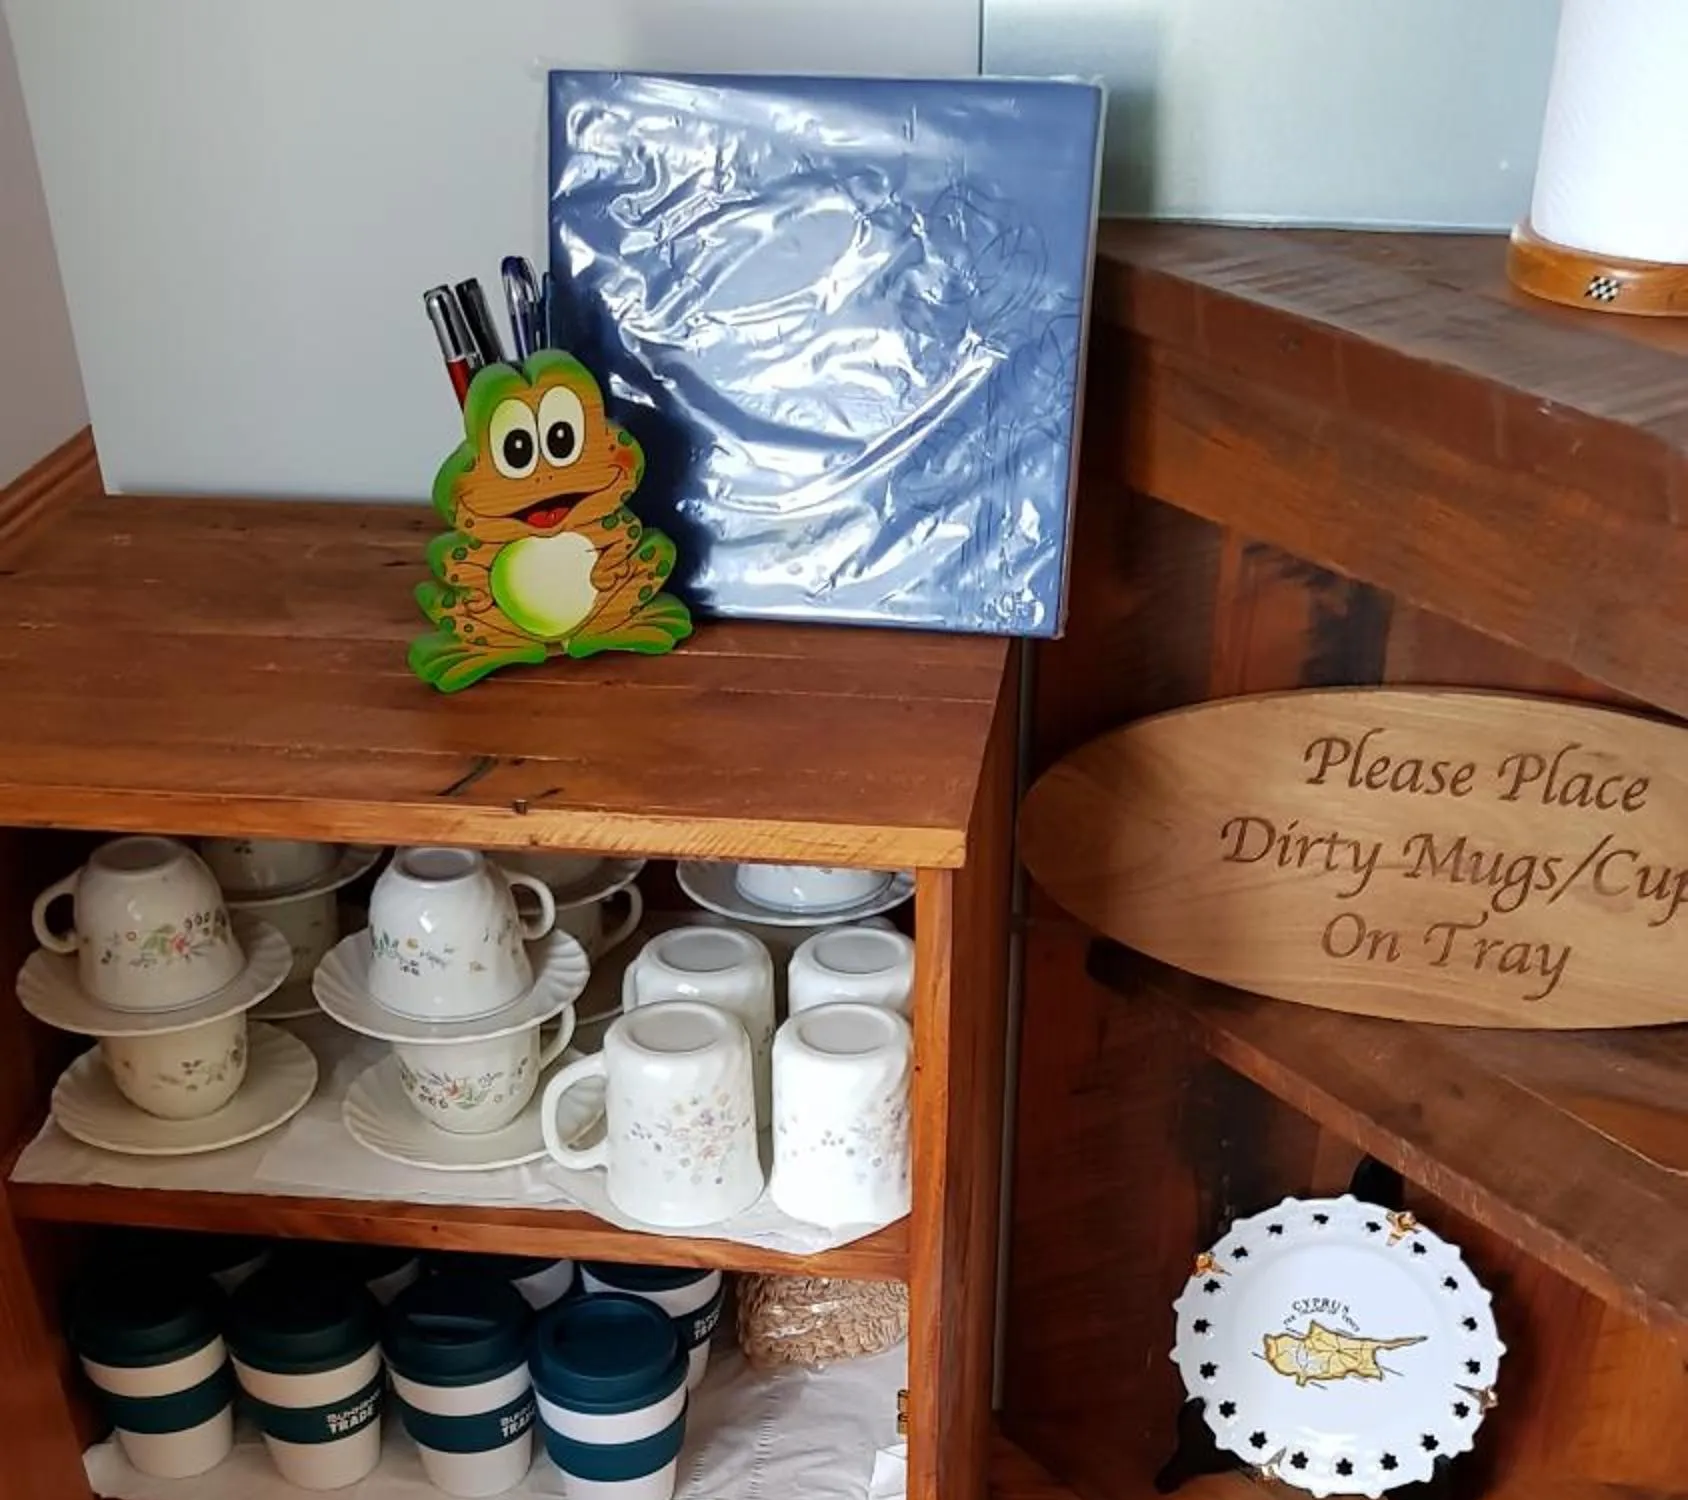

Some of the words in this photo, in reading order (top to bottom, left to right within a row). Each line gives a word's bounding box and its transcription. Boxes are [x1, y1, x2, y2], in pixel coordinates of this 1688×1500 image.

[1303, 727, 1475, 797] Please
[1496, 742, 1651, 812] Place
[1220, 815, 1383, 898] Dirty
[1320, 912, 1400, 963] On
[1422, 911, 1572, 1000] Tray
[1292, 1297, 1350, 1313] CYPRUS
[329, 1404, 374, 1434] TRADE
